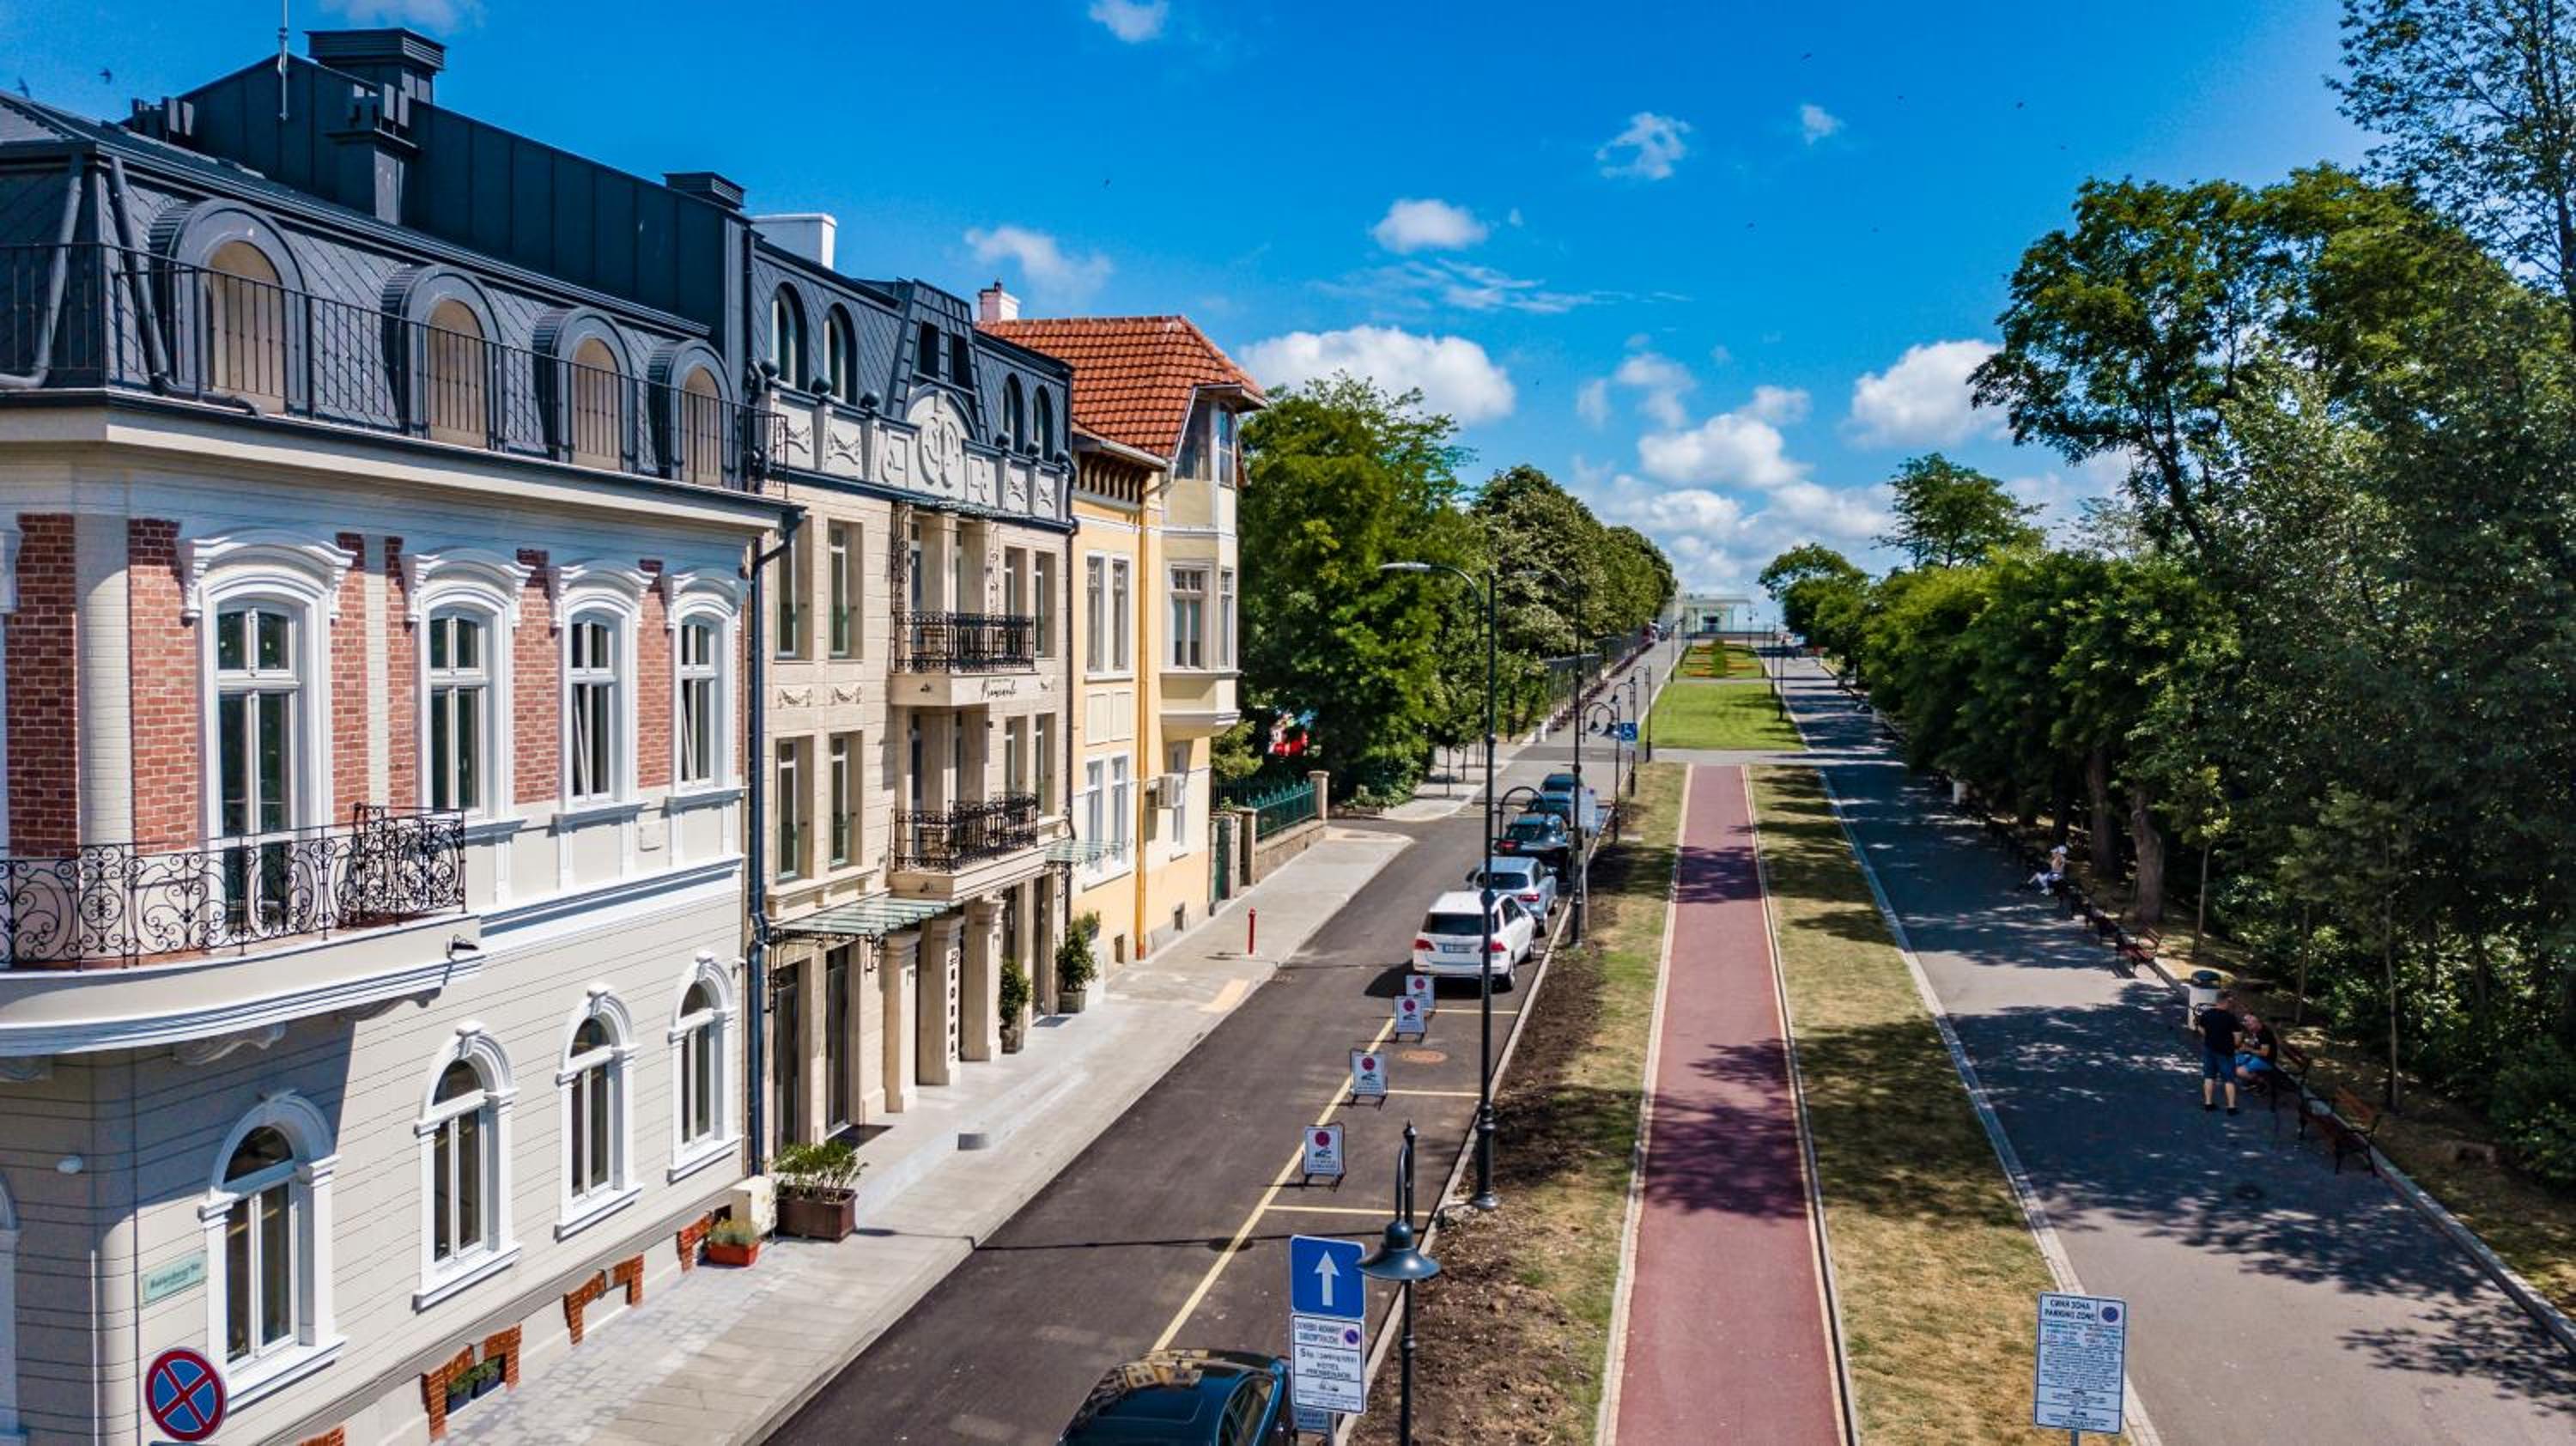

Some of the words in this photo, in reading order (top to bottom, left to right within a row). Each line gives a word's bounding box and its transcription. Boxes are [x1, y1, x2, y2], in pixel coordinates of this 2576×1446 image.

[2050, 1298, 2070, 1308] СИНЯ
[2070, 1301, 2091, 1310] ЗОНА
[2044, 1309, 2075, 1320] PARKING
[2075, 1311, 2096, 1321] ZONE
